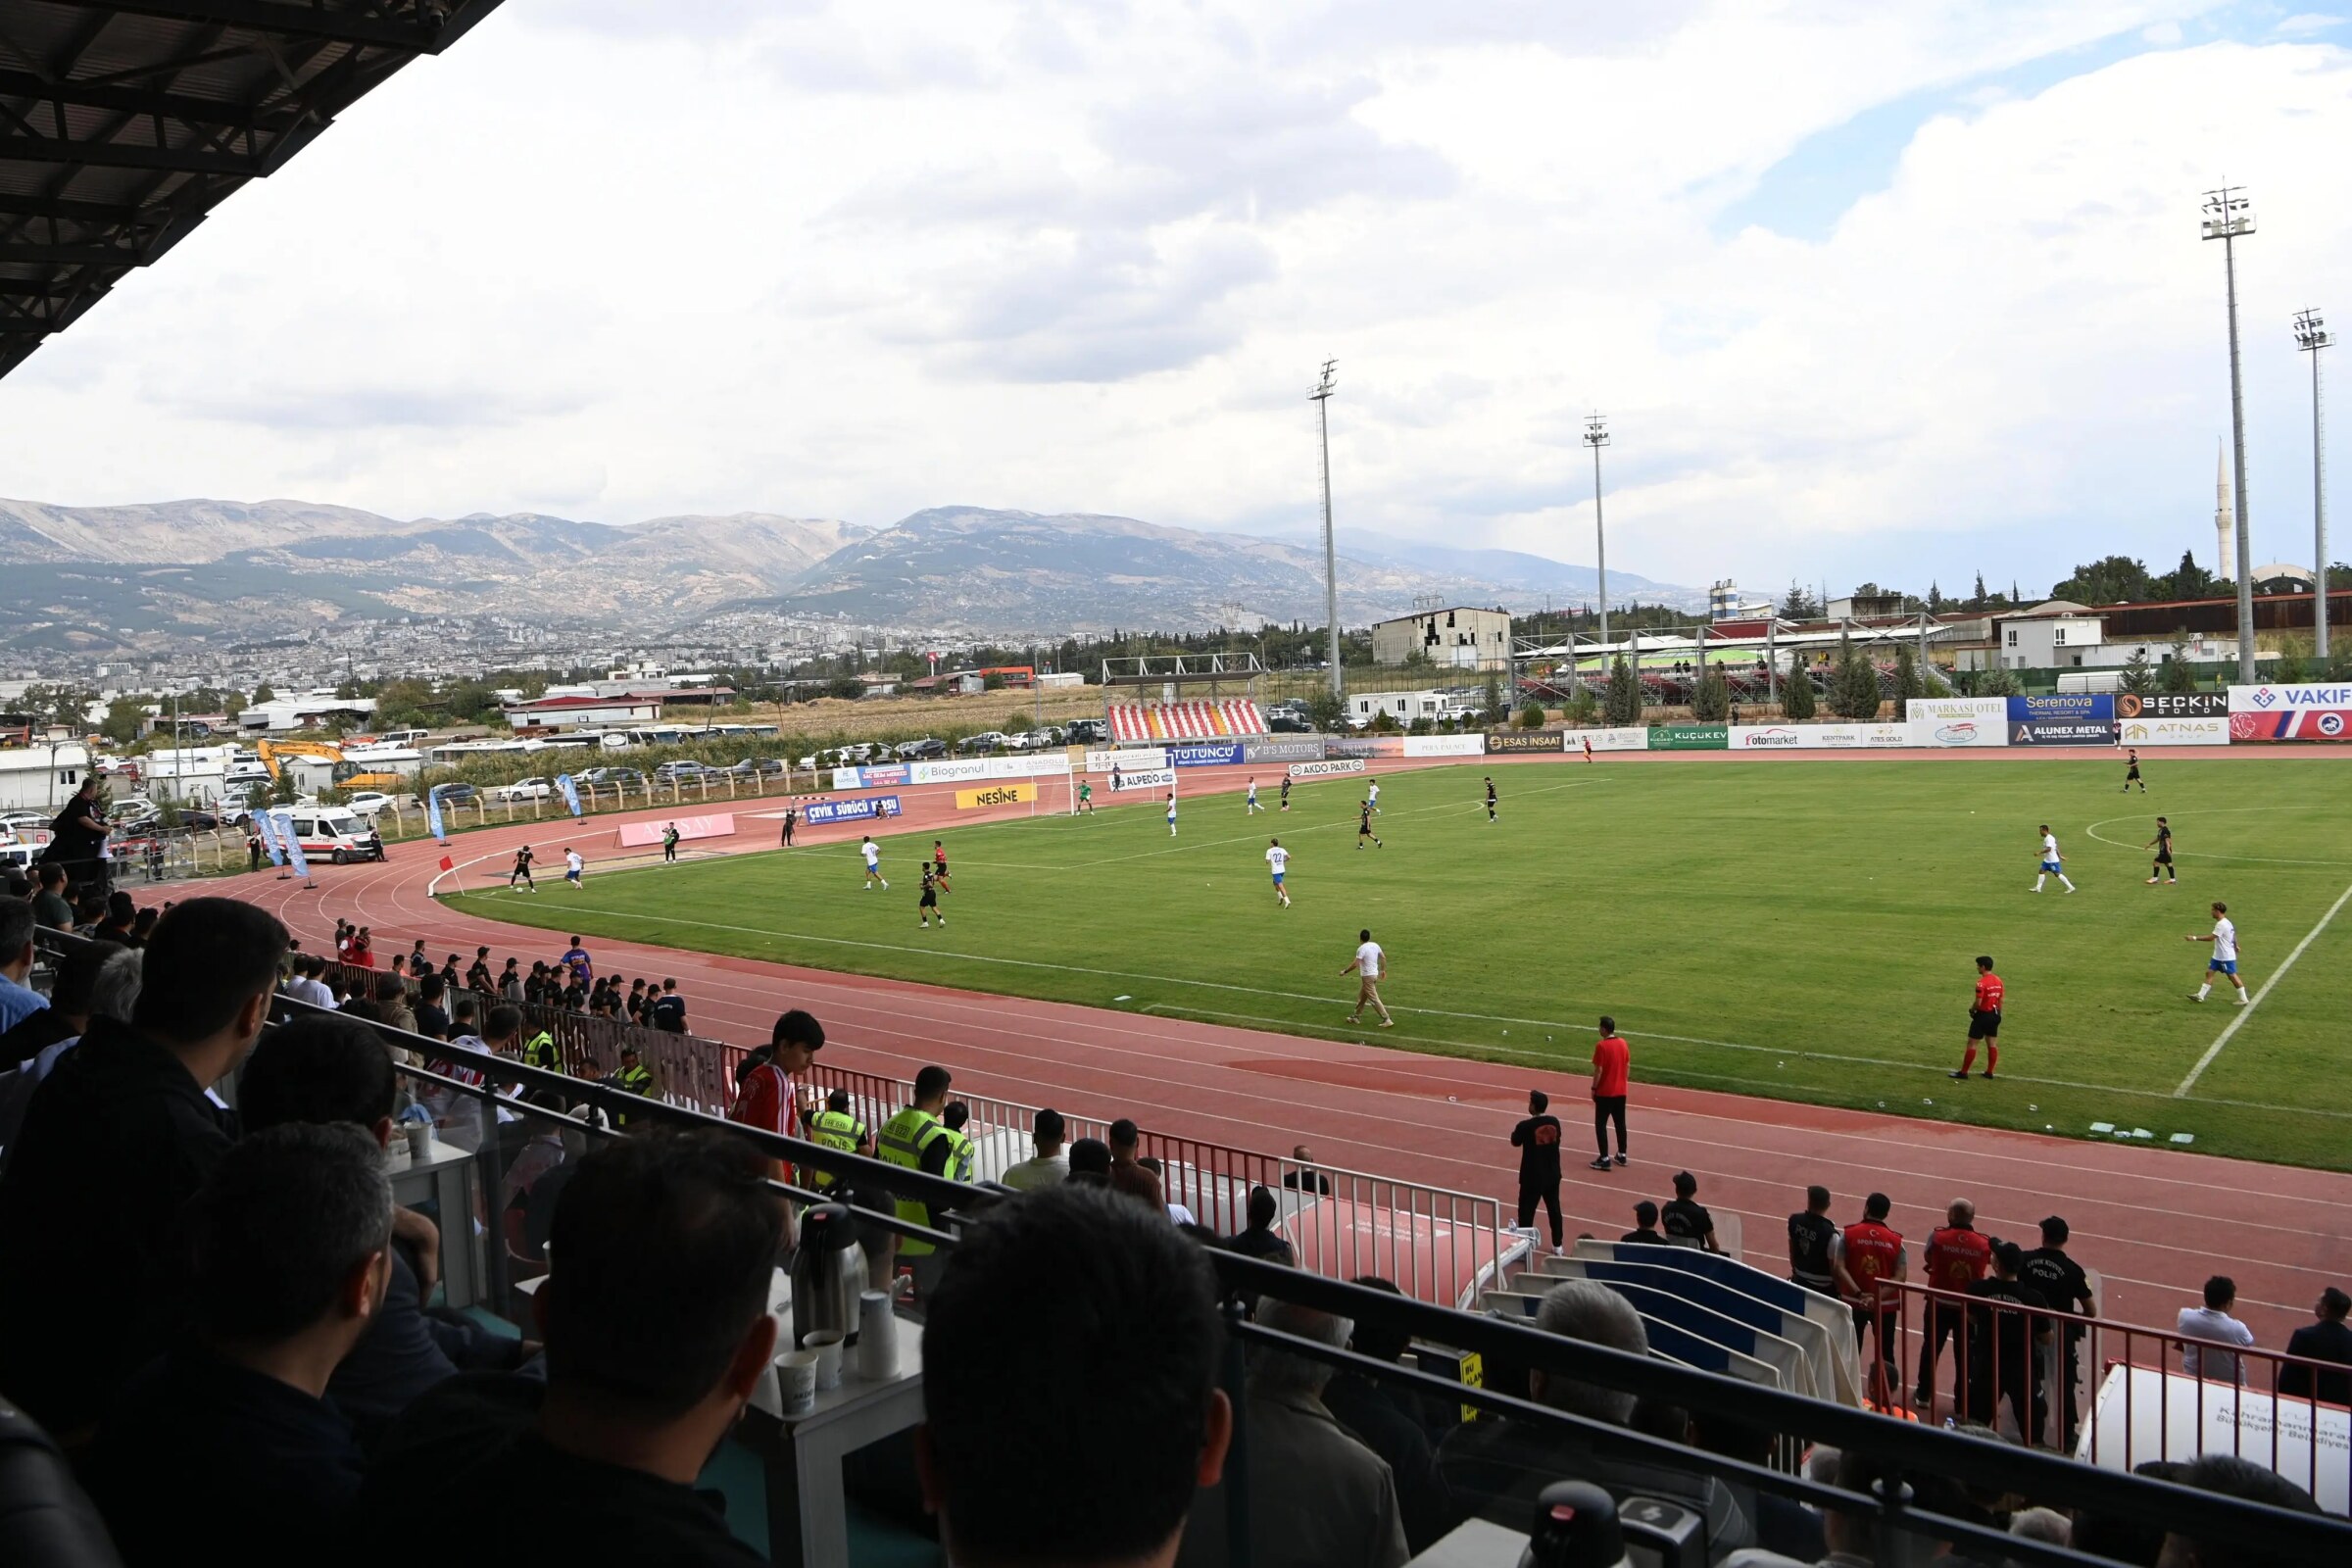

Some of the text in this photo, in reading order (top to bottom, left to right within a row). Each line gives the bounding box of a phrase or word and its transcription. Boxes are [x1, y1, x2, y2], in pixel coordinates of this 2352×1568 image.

[2026, 696, 2092, 708] Serenova
[2285, 689, 2351, 704] VAKIF
[1977, 703, 2004, 713] OTEL
[2034, 727, 2074, 735] ALUNEX
[2156, 723, 2219, 732] ATNAS
[1504, 737, 1527, 747] ESAS
[1173, 747, 1234, 760] TÜTÜNCÜ
[1263, 746, 1277, 754] B'S
[1279, 744, 1318, 754] MOTORS
[931, 764, 984, 777] Biogranul
[1304, 762, 1351, 774] AKDO PARK
[1127, 774, 1160, 786] ALPEDO
[809, 804, 833, 820] ÇEVİK
[836, 799, 868, 816] SÜRÜCÜ
[871, 799, 897, 811] KRSU
[1273, 852, 1282, 863] 22
